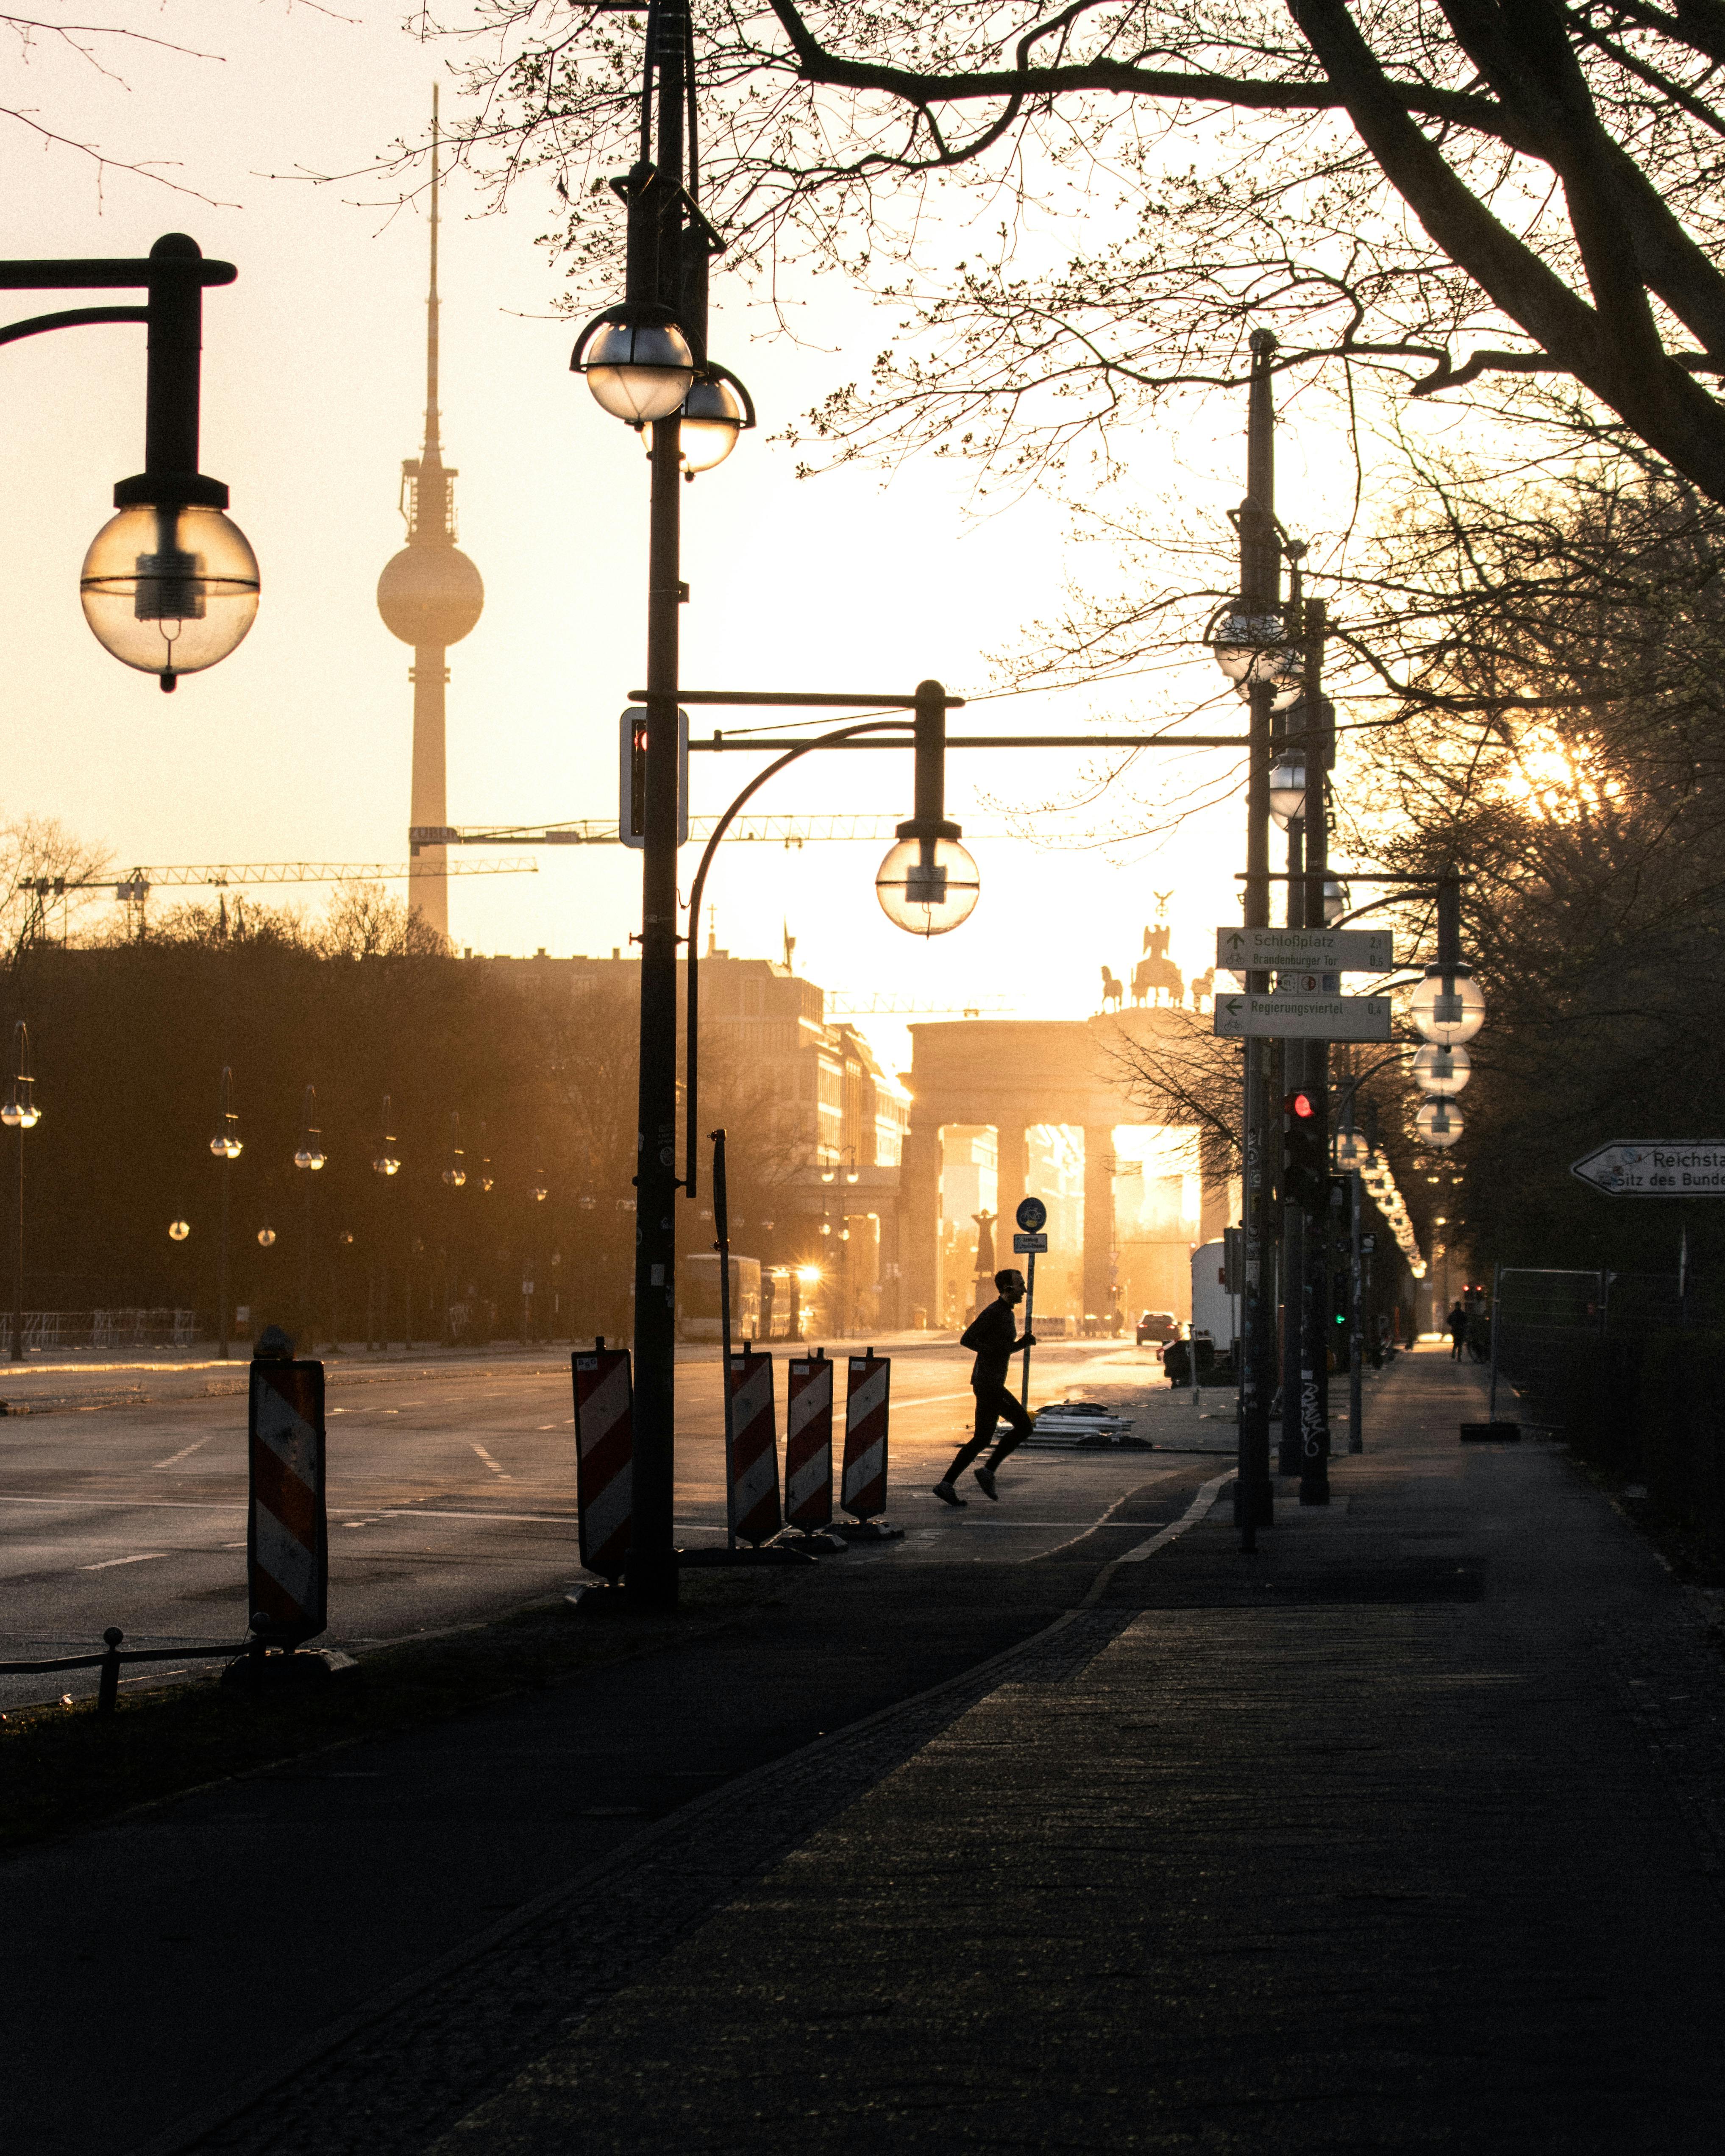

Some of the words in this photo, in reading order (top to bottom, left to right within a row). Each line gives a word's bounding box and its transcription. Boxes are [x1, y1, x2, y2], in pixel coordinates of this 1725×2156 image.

[1254, 935, 1334, 949] Schloßplatz
[1253, 954, 1321, 968] Brandenburger
[1324, 955, 1338, 966] Tor
[1252, 1001, 1343, 1016] Regierungsviertel
[1650, 1173, 1675, 1186] des
